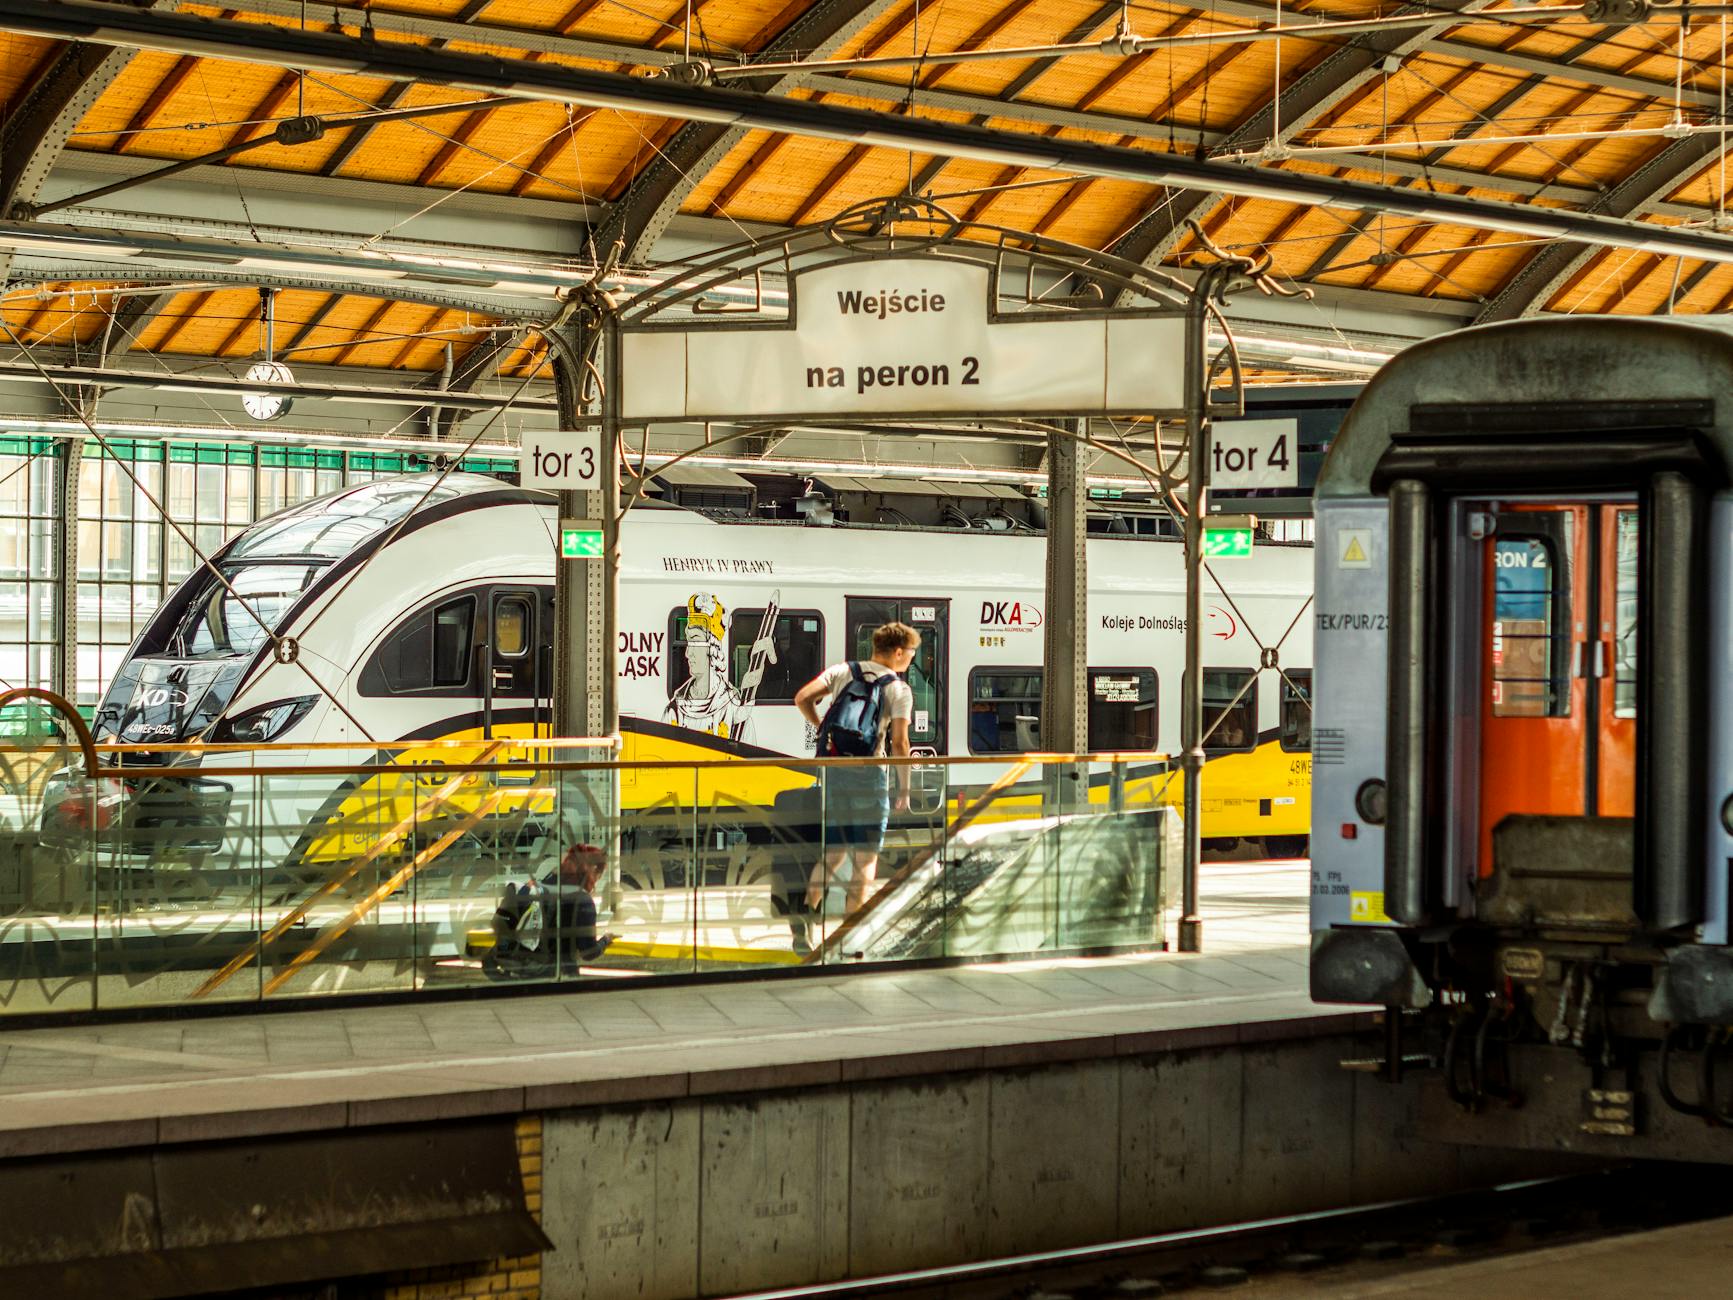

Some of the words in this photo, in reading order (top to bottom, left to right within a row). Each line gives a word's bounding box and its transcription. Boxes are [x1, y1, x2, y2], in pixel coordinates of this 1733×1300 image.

[837, 289, 945, 319] Wejście
[806, 366, 845, 387] na
[857, 363, 949, 394] peron
[961, 356, 980, 385] 2
[533, 445, 573, 478] tor
[579, 446, 595, 480] 3
[1213, 441, 1258, 472] tor
[1267, 434, 1290, 471] 4
[662, 557, 714, 572] HENRYK
[717, 559, 729, 573] IV
[732, 560, 774, 574] PRAWY
[980, 601, 1022, 625] DKA
[1102, 615, 1135, 632] Koleje
[619, 656, 661, 680] ĄSK
[135, 689, 169, 707] KD
[127, 723, 175, 735] 48WEc-025a
